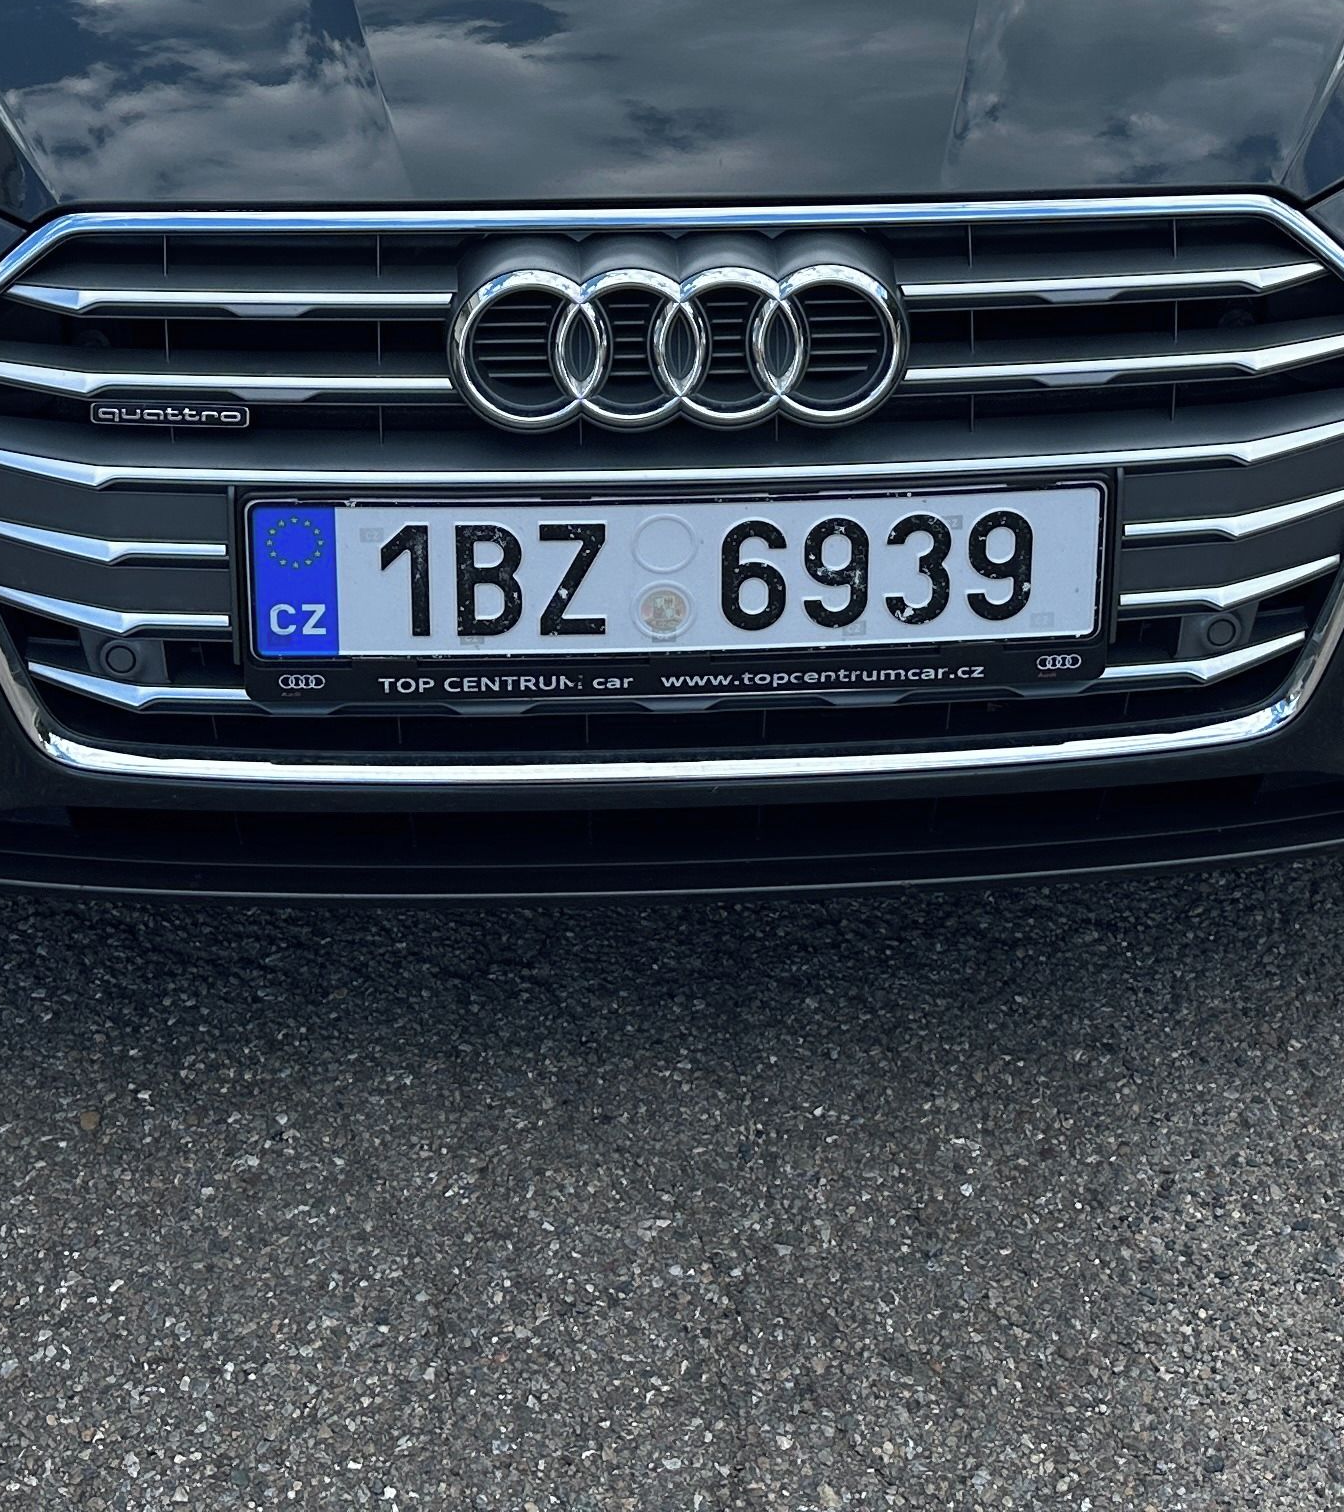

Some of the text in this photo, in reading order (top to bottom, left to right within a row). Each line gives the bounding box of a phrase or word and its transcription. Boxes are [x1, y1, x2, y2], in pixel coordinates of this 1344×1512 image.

[97, 407, 242, 423] quattro
[379, 508, 1034, 637] 1BZ 6939
[269, 603, 327, 636] CZ
[377, 677, 435, 694] TOP
[592, 676, 634, 689] car
[660, 666, 985, 687] www.topcentrumcar.cz
